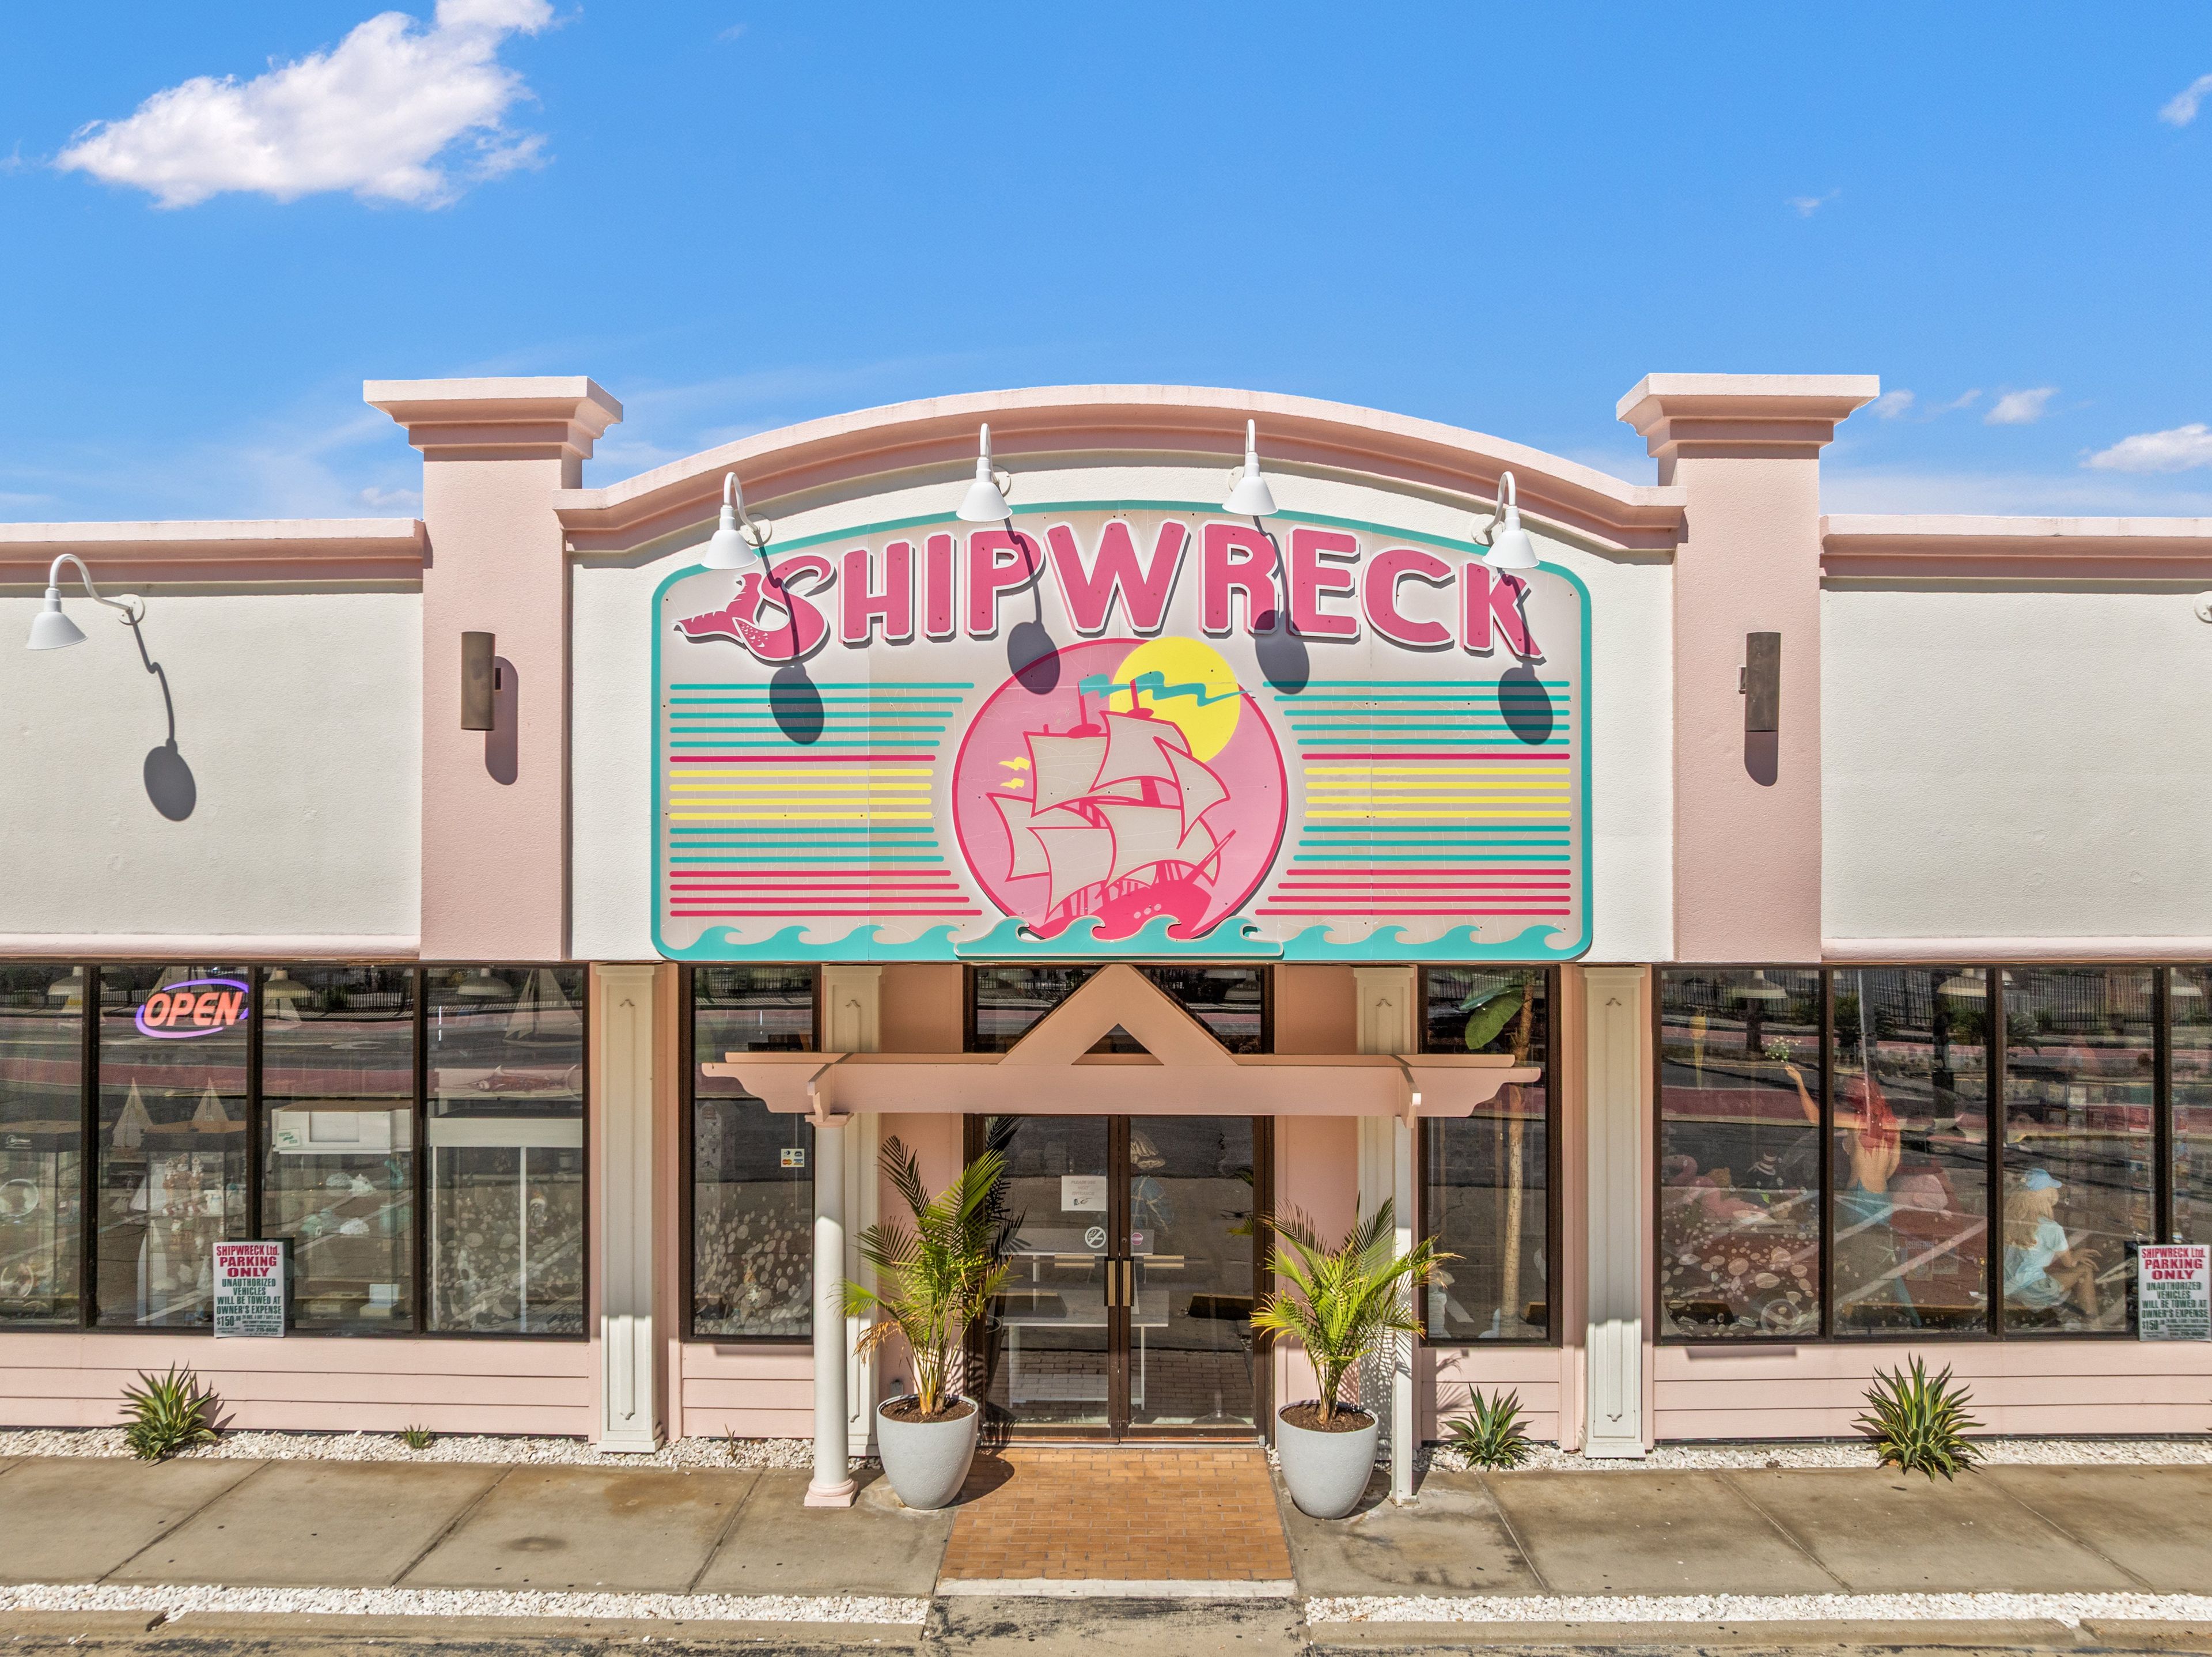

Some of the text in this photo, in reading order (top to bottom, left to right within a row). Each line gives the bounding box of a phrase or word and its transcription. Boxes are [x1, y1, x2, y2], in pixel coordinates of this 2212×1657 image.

[672, 519, 1543, 661] SHIPWRECK
[144, 992, 243, 1027] OPEN
[217, 1245, 279, 1256] SHIPWRECK Ltd.
[2142, 1247, 2206, 1258] SHIPWRECK Ltd.
[219, 1257, 276, 1267] PARKING
[2145, 1259, 2203, 1269] PARKING
[227, 1268, 270, 1277] ONLY
[2152, 1270, 2195, 1280] ONLY
[222, 1278, 276, 1287] UNAUTHORIZED
[2146, 1282, 2201, 1291] UNAUTHORIZED
[233, 1287, 266, 1295] VEHICLES
[2157, 1291, 2191, 1299] VEHICLES
[217, 1296, 281, 1304] WILL BE TOWED AT
[2142, 1300, 2207, 1308] WILL BE TOWED AT
[217, 1306, 281, 1314] OWNER'S EXPENSE
[2142, 1309, 2209, 1318] OWNER'S EXPENSE
